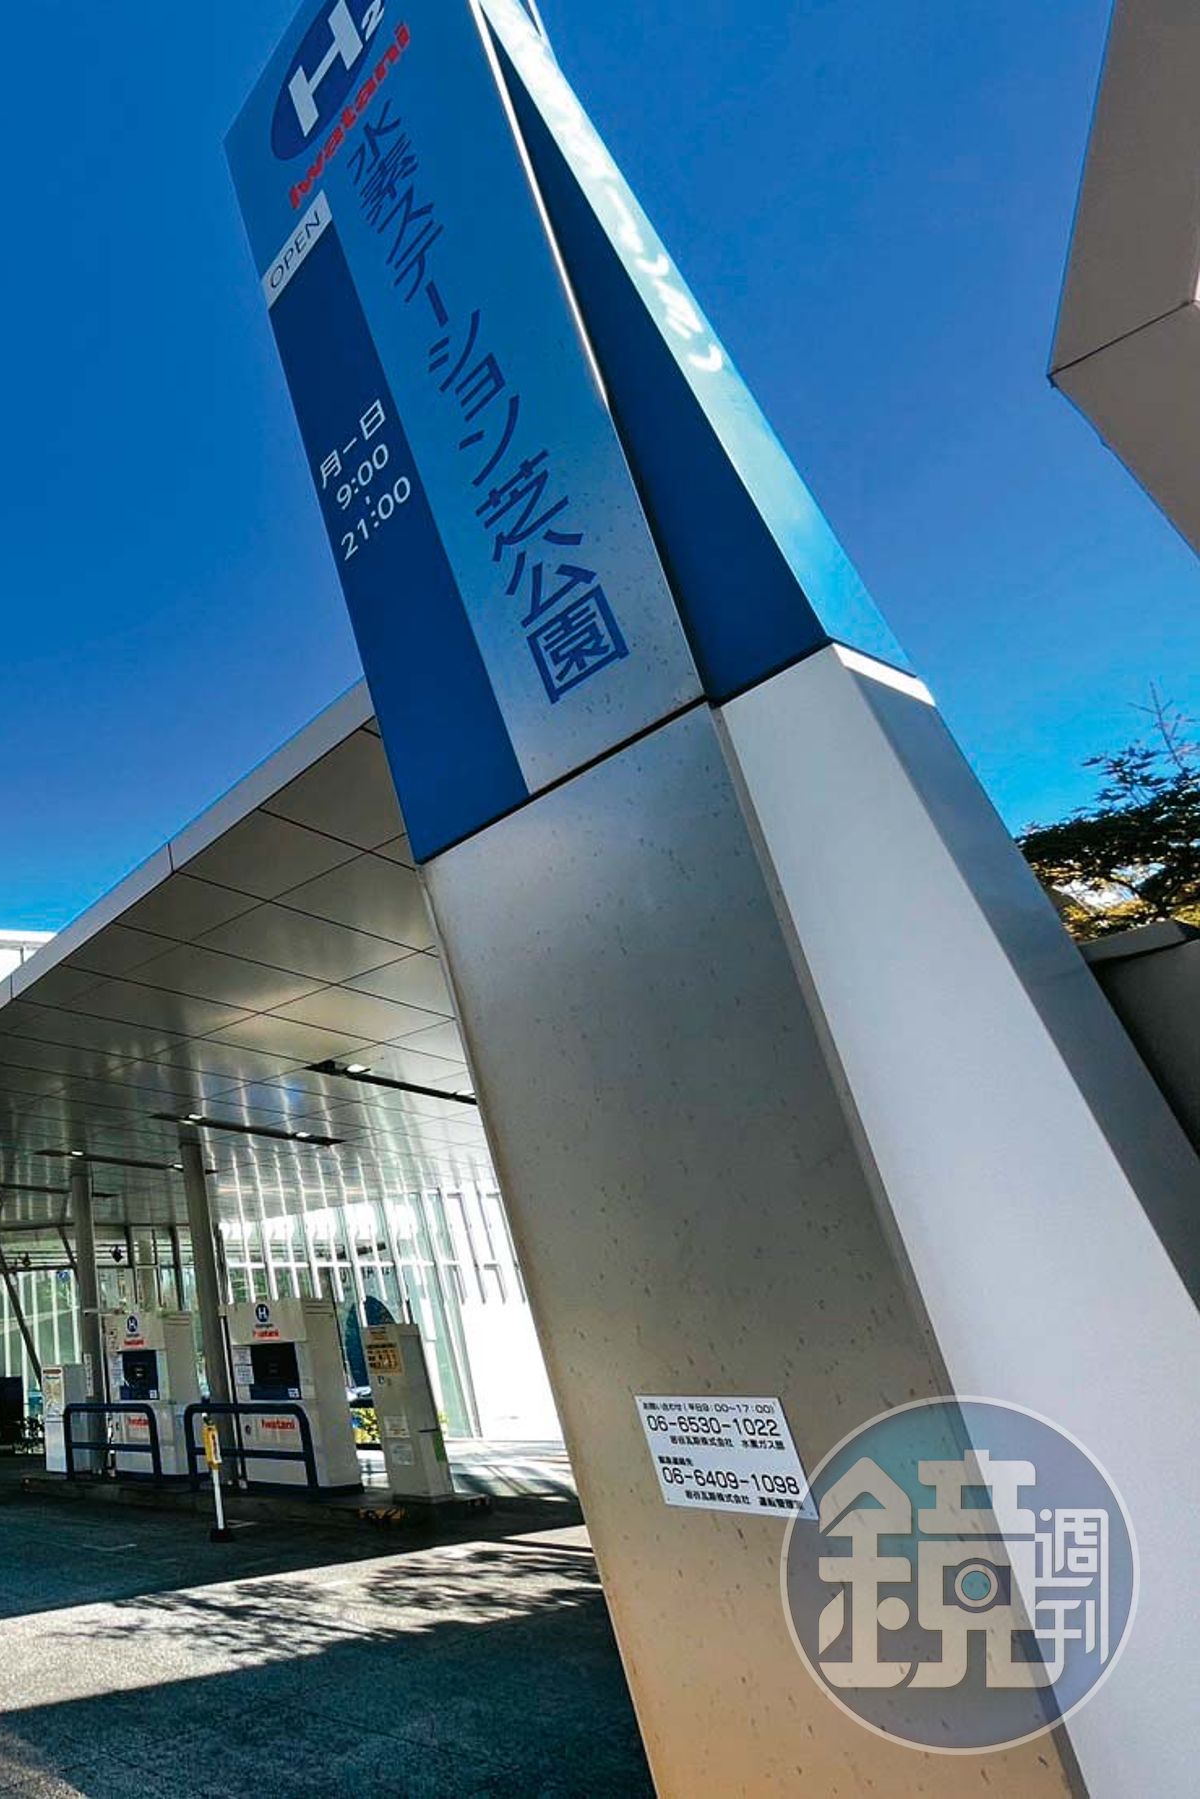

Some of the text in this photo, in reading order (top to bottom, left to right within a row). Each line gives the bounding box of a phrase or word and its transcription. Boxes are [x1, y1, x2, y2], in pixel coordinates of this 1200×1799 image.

[290, 23, 410, 209] Iwatani
[269, 210, 321, 289] OPEN
[347, 98, 629, 704] 水素ステーション芝公園
[335, 443, 389, 510] 9:00
[340, 475, 411, 561] 21:00
[646, 1414, 781, 1437] 06-6530-1022
[662, 1466, 801, 1495] 06-6409-1098
